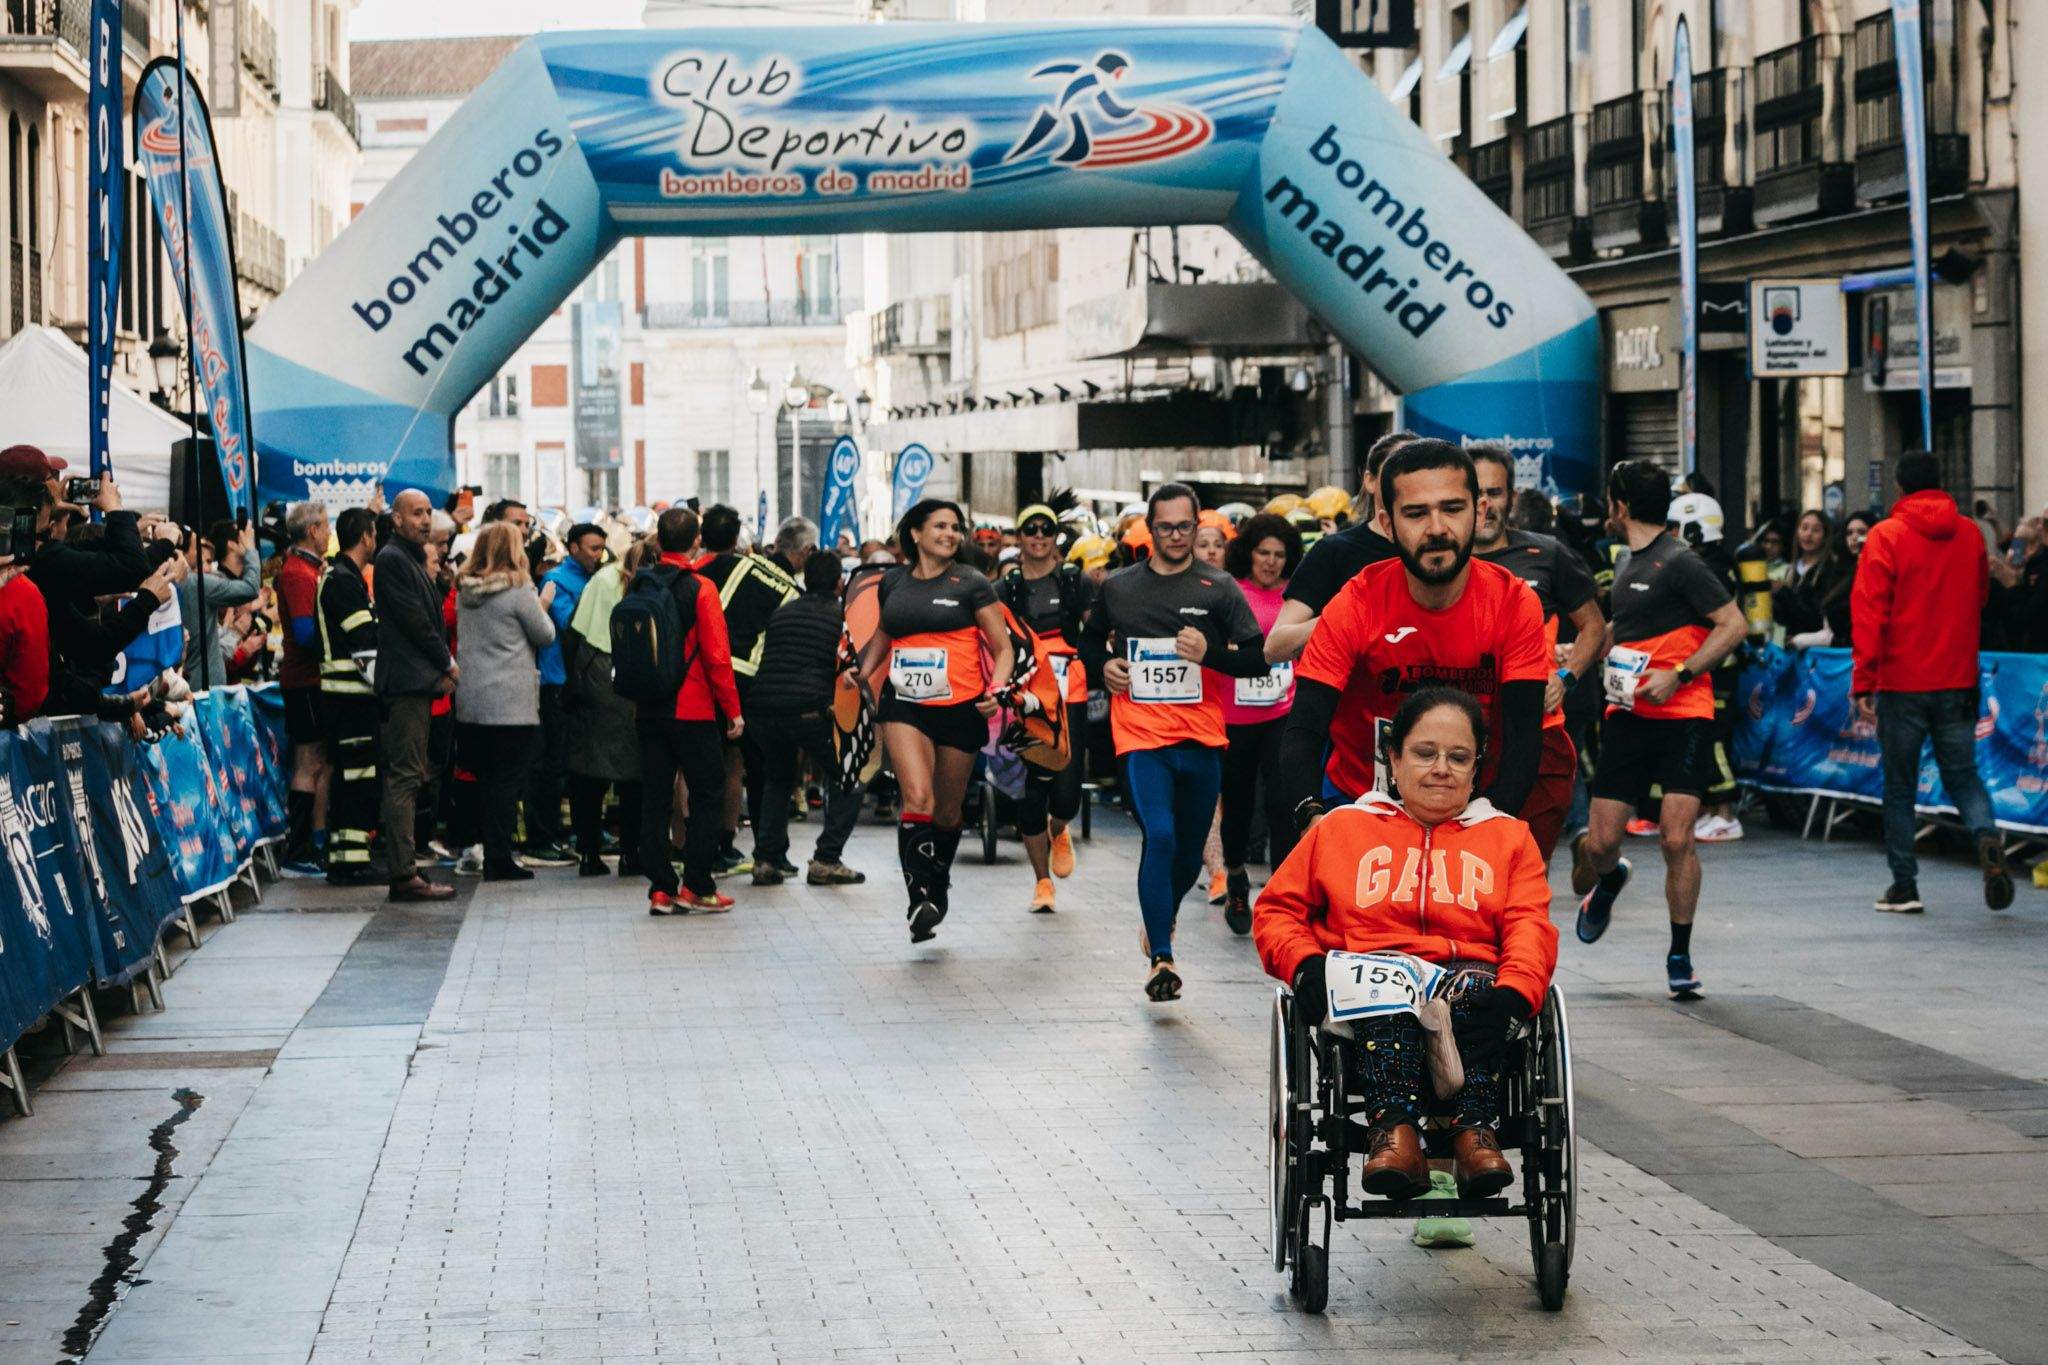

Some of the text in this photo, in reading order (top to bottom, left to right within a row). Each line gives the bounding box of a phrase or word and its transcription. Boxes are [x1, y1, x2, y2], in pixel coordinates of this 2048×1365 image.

[664, 58, 790, 100] Club
[691, 100, 966, 171] Deportivo
[663, 165, 970, 195] bomberos de madrid
[353, 128, 562, 332] bomberos
[1309, 124, 1514, 329] bomberos
[1265, 176, 1446, 338] madrid
[402, 198, 570, 377] madrid
[293, 458, 388, 477] bomberos
[904, 672, 933, 687] 270
[1142, 666, 1188, 684] 1557
[1248, 674, 1282, 688] 1581
[1355, 844, 1495, 912] GAP
